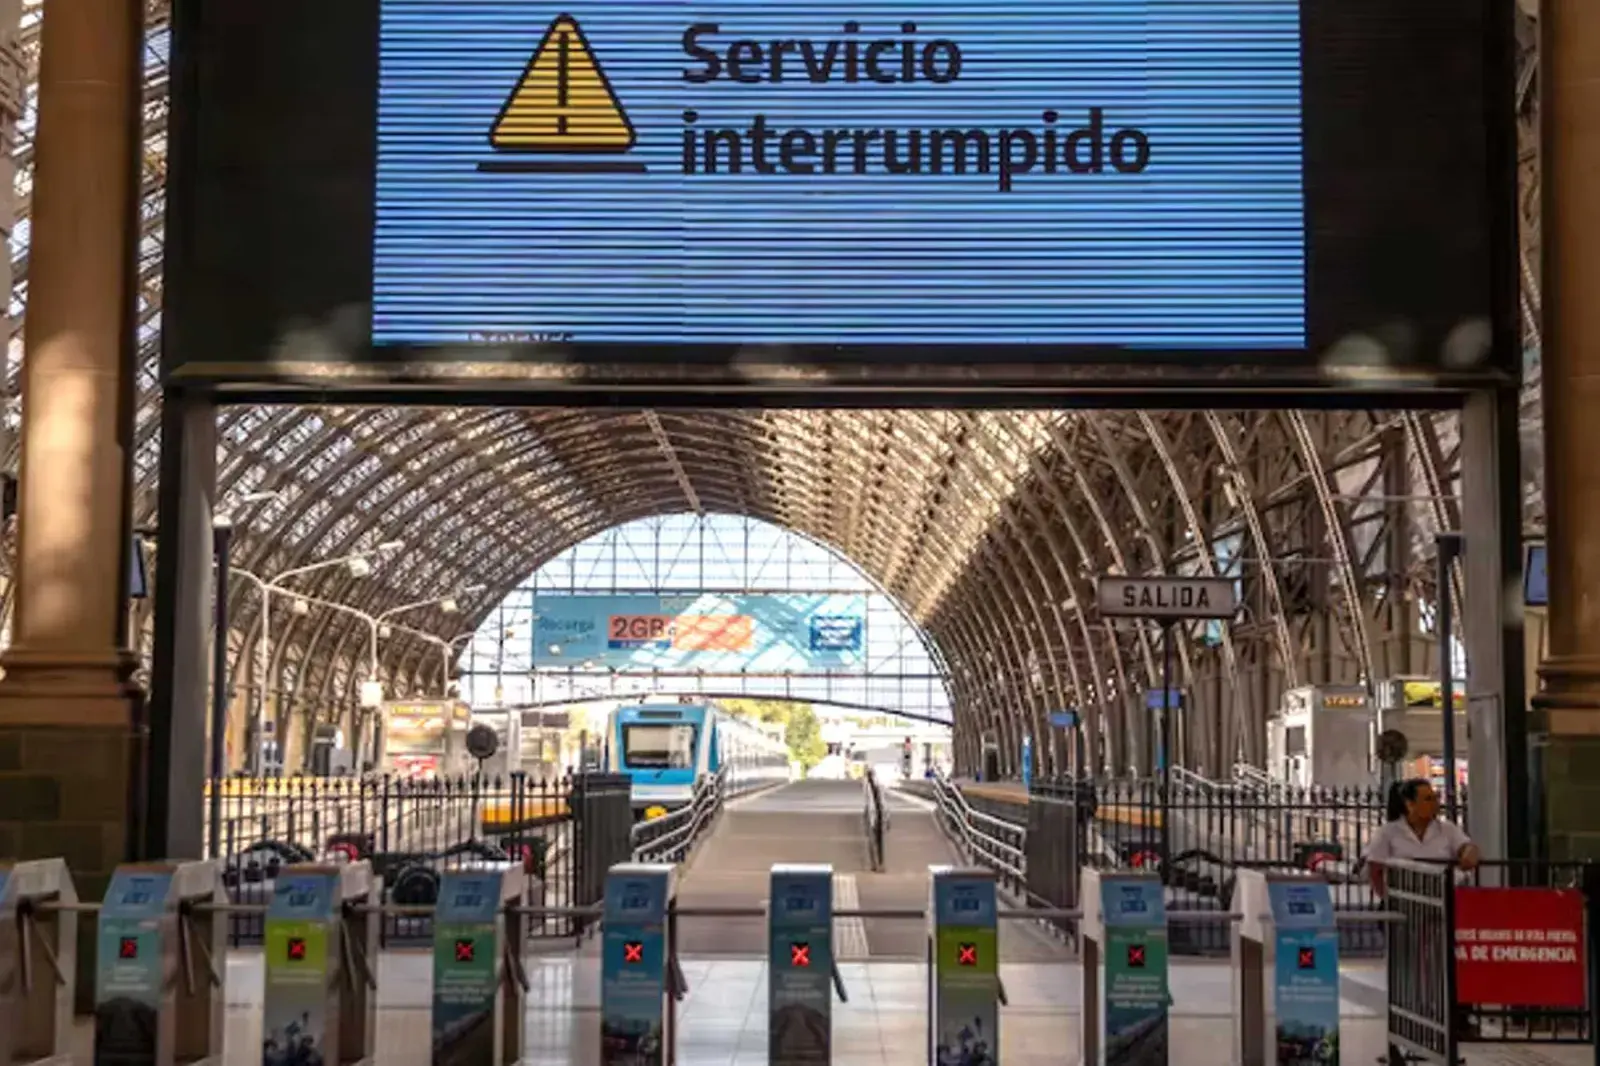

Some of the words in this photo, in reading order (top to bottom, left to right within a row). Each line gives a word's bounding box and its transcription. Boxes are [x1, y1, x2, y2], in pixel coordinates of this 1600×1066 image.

[682, 21, 962, 84] Servicio
[682, 106, 1151, 192] interrumpido
[1123, 585, 1210, 608] SALIDA
[612, 616, 664, 638] 2GB
[1471, 945, 1488, 961] DE
[1492, 945, 1577, 963] EMERGENCIA
